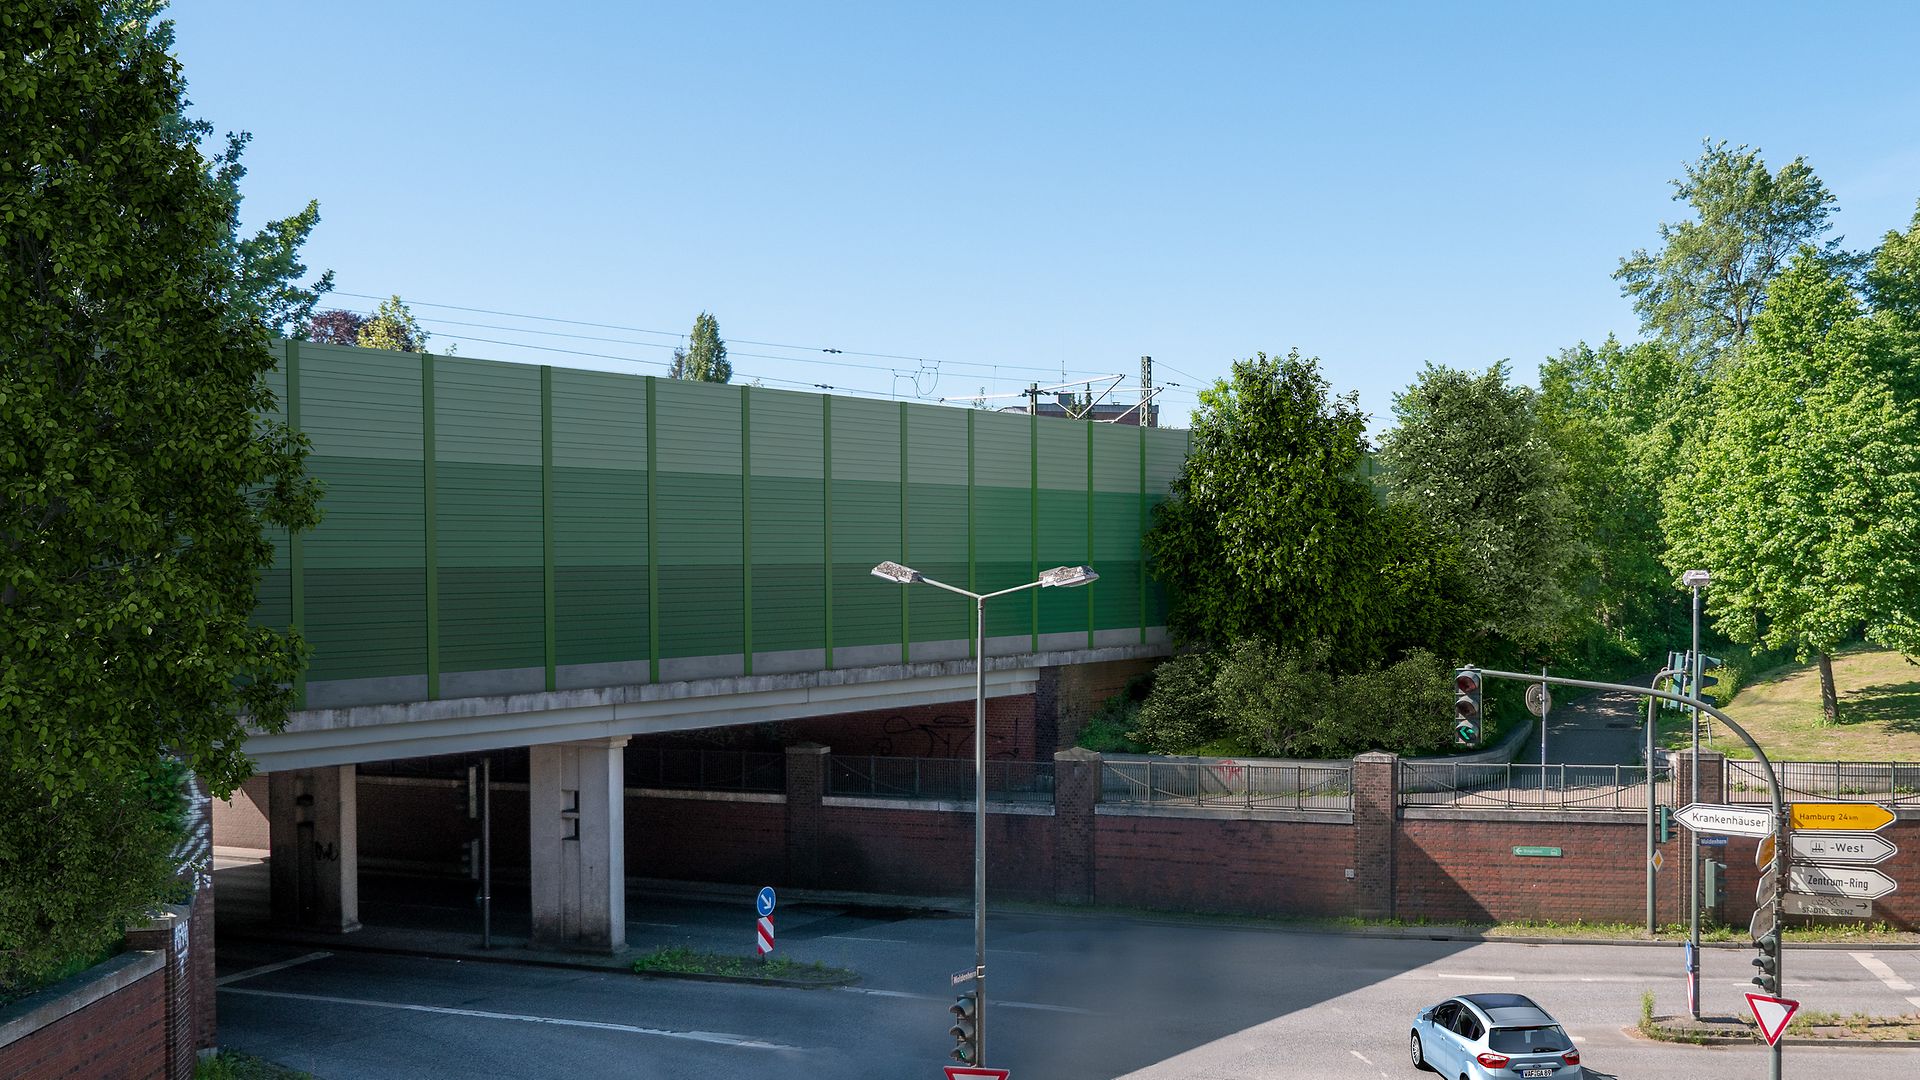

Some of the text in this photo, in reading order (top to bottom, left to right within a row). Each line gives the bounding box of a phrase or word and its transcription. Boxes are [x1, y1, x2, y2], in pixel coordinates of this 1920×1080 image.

[1692, 813, 1766, 827] Krankenhäuser
[1799, 813, 1835, 821] Hamburg
[1830, 843, 1864, 853] -West
[1807, 874, 1869, 891] Zentrum-Ring
[1802, 906, 1854, 916] STADTRIDENZ
